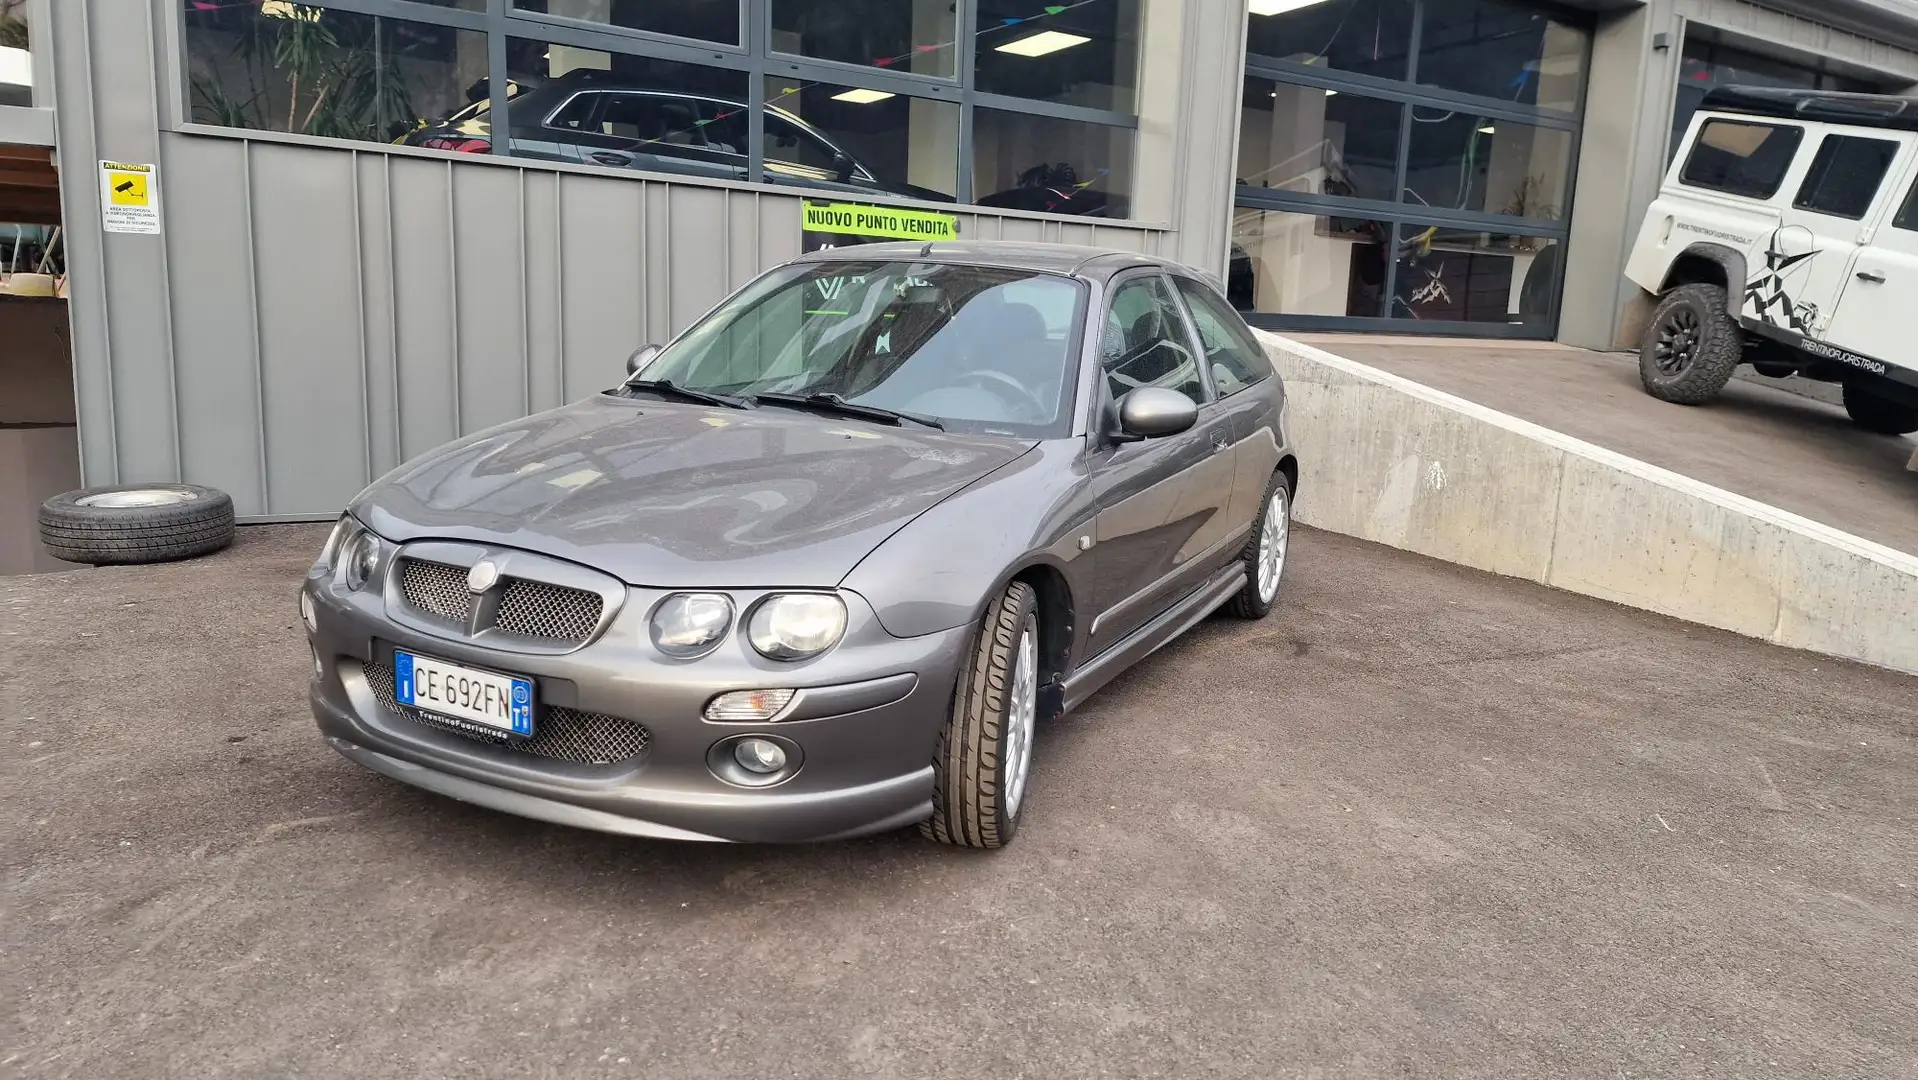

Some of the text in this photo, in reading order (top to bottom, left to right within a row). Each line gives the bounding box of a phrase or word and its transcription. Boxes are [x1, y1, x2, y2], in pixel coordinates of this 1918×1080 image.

[105, 163, 150, 172] ATTENZIONE!
[808, 209, 949, 236] NUOVO PUNTO VENDITA
[1801, 339, 1886, 375] TRENTINOFUORISTRADA
[415, 667, 439, 701] CE
[446, 675, 510, 719] 692FN
[419, 710, 508, 739] TrentinoFuoristrada
